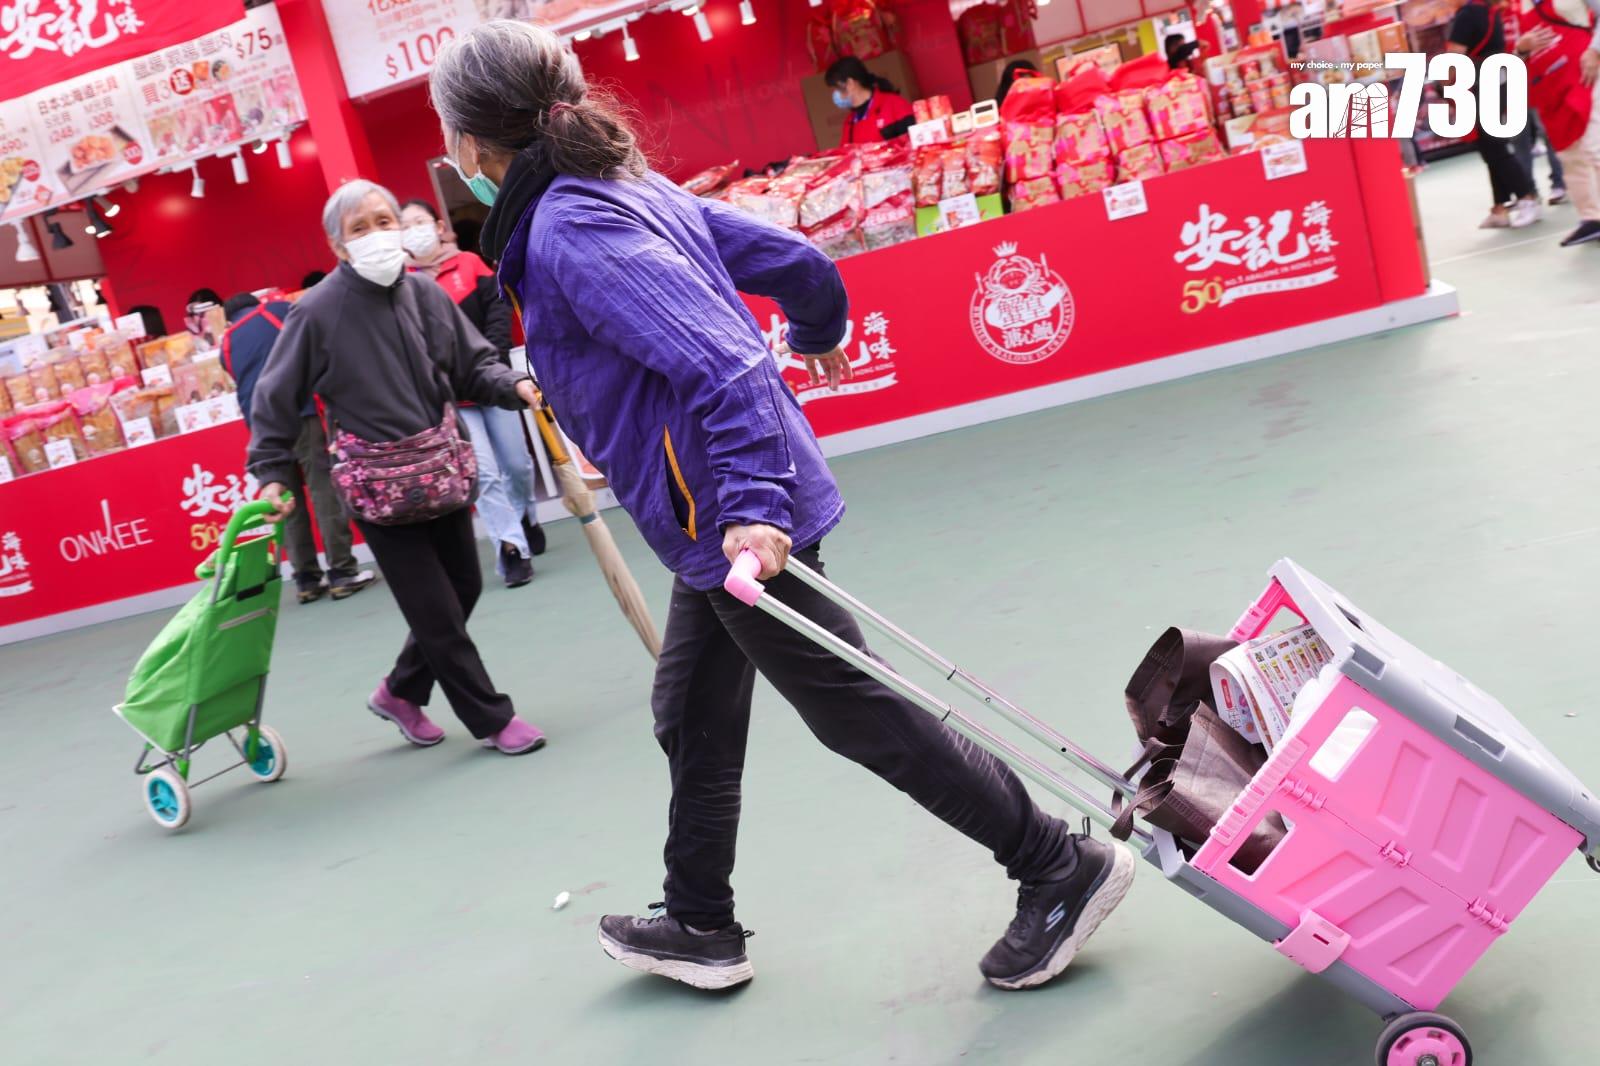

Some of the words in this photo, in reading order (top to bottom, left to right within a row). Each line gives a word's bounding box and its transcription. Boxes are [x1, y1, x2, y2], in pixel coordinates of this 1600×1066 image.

[235, 28, 273, 58] $75
[1173, 203, 1310, 271] 安記
[1301, 200, 1339, 253] 海味
[862, 311, 897, 360] 海味
[60, 500, 152, 561] ONKEE
